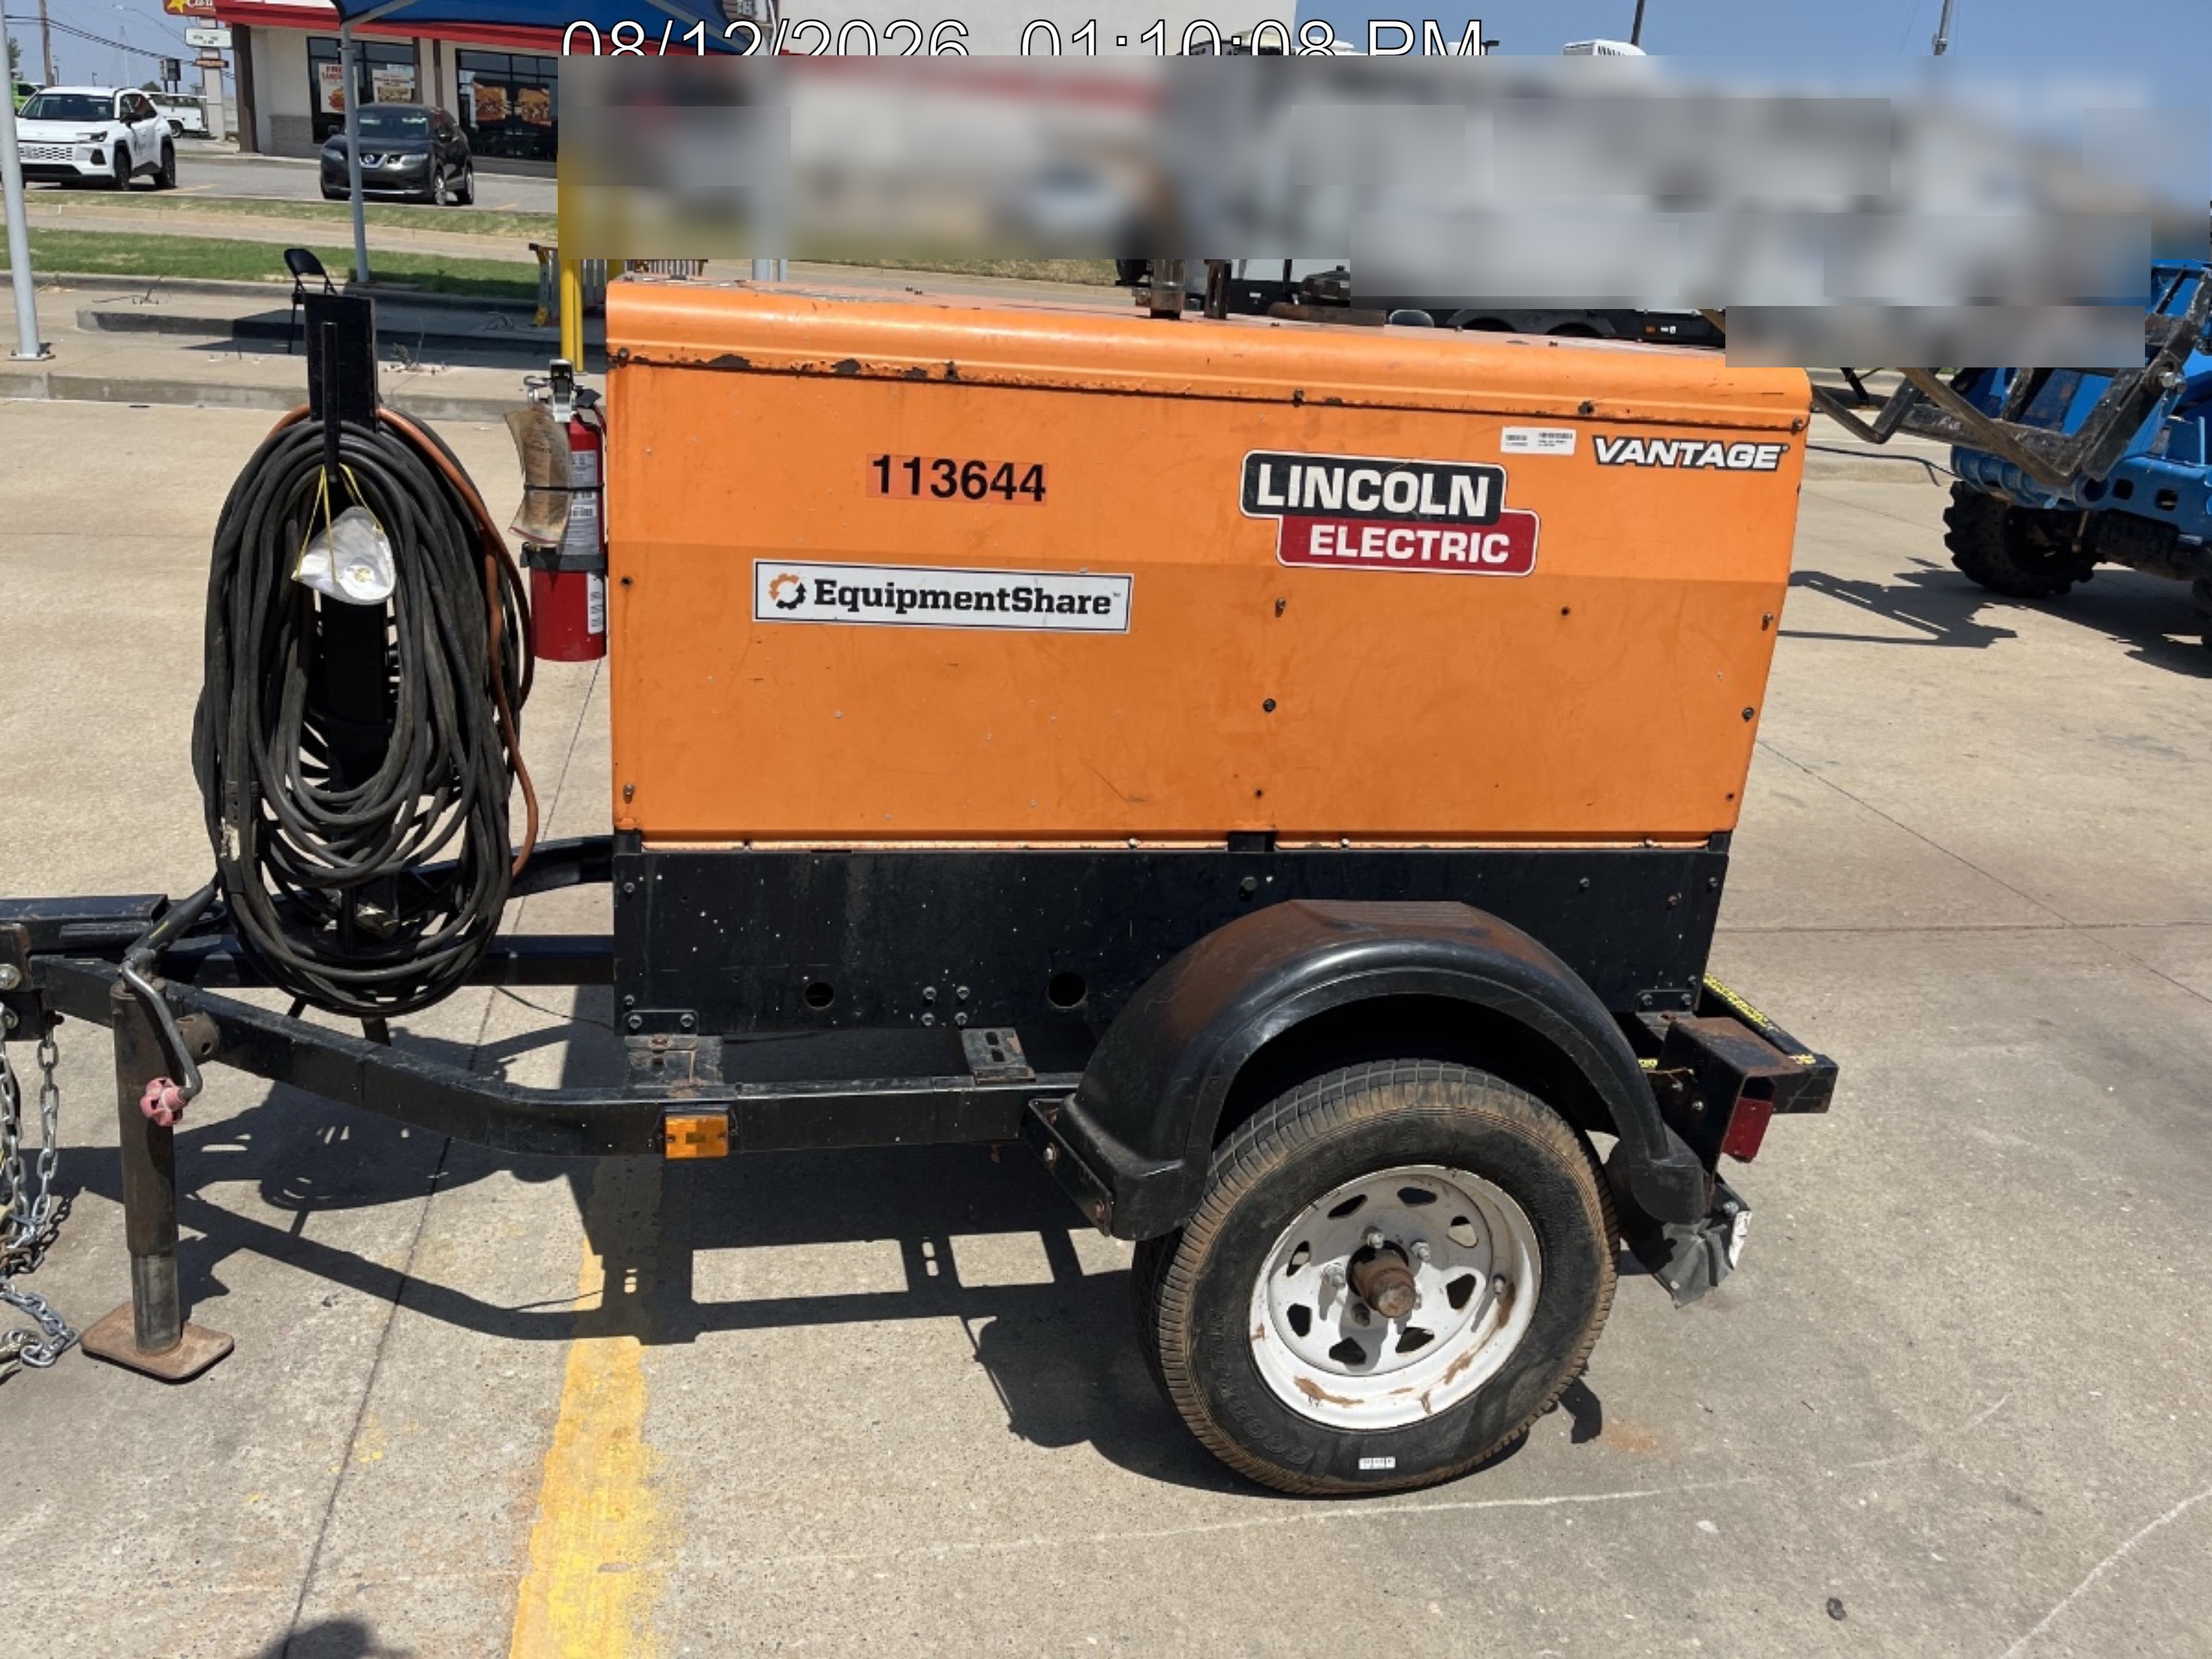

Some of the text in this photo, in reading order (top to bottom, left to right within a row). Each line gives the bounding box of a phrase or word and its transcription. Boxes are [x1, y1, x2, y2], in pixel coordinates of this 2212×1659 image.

[1593, 436, 1783, 471] VANTAGE
[873, 455, 1046, 502] 113644
[1257, 464, 1489, 517] LINCOLN
[1310, 525, 1509, 563] ELECTRIC
[814, 579, 1111, 614] EquipmentShare
